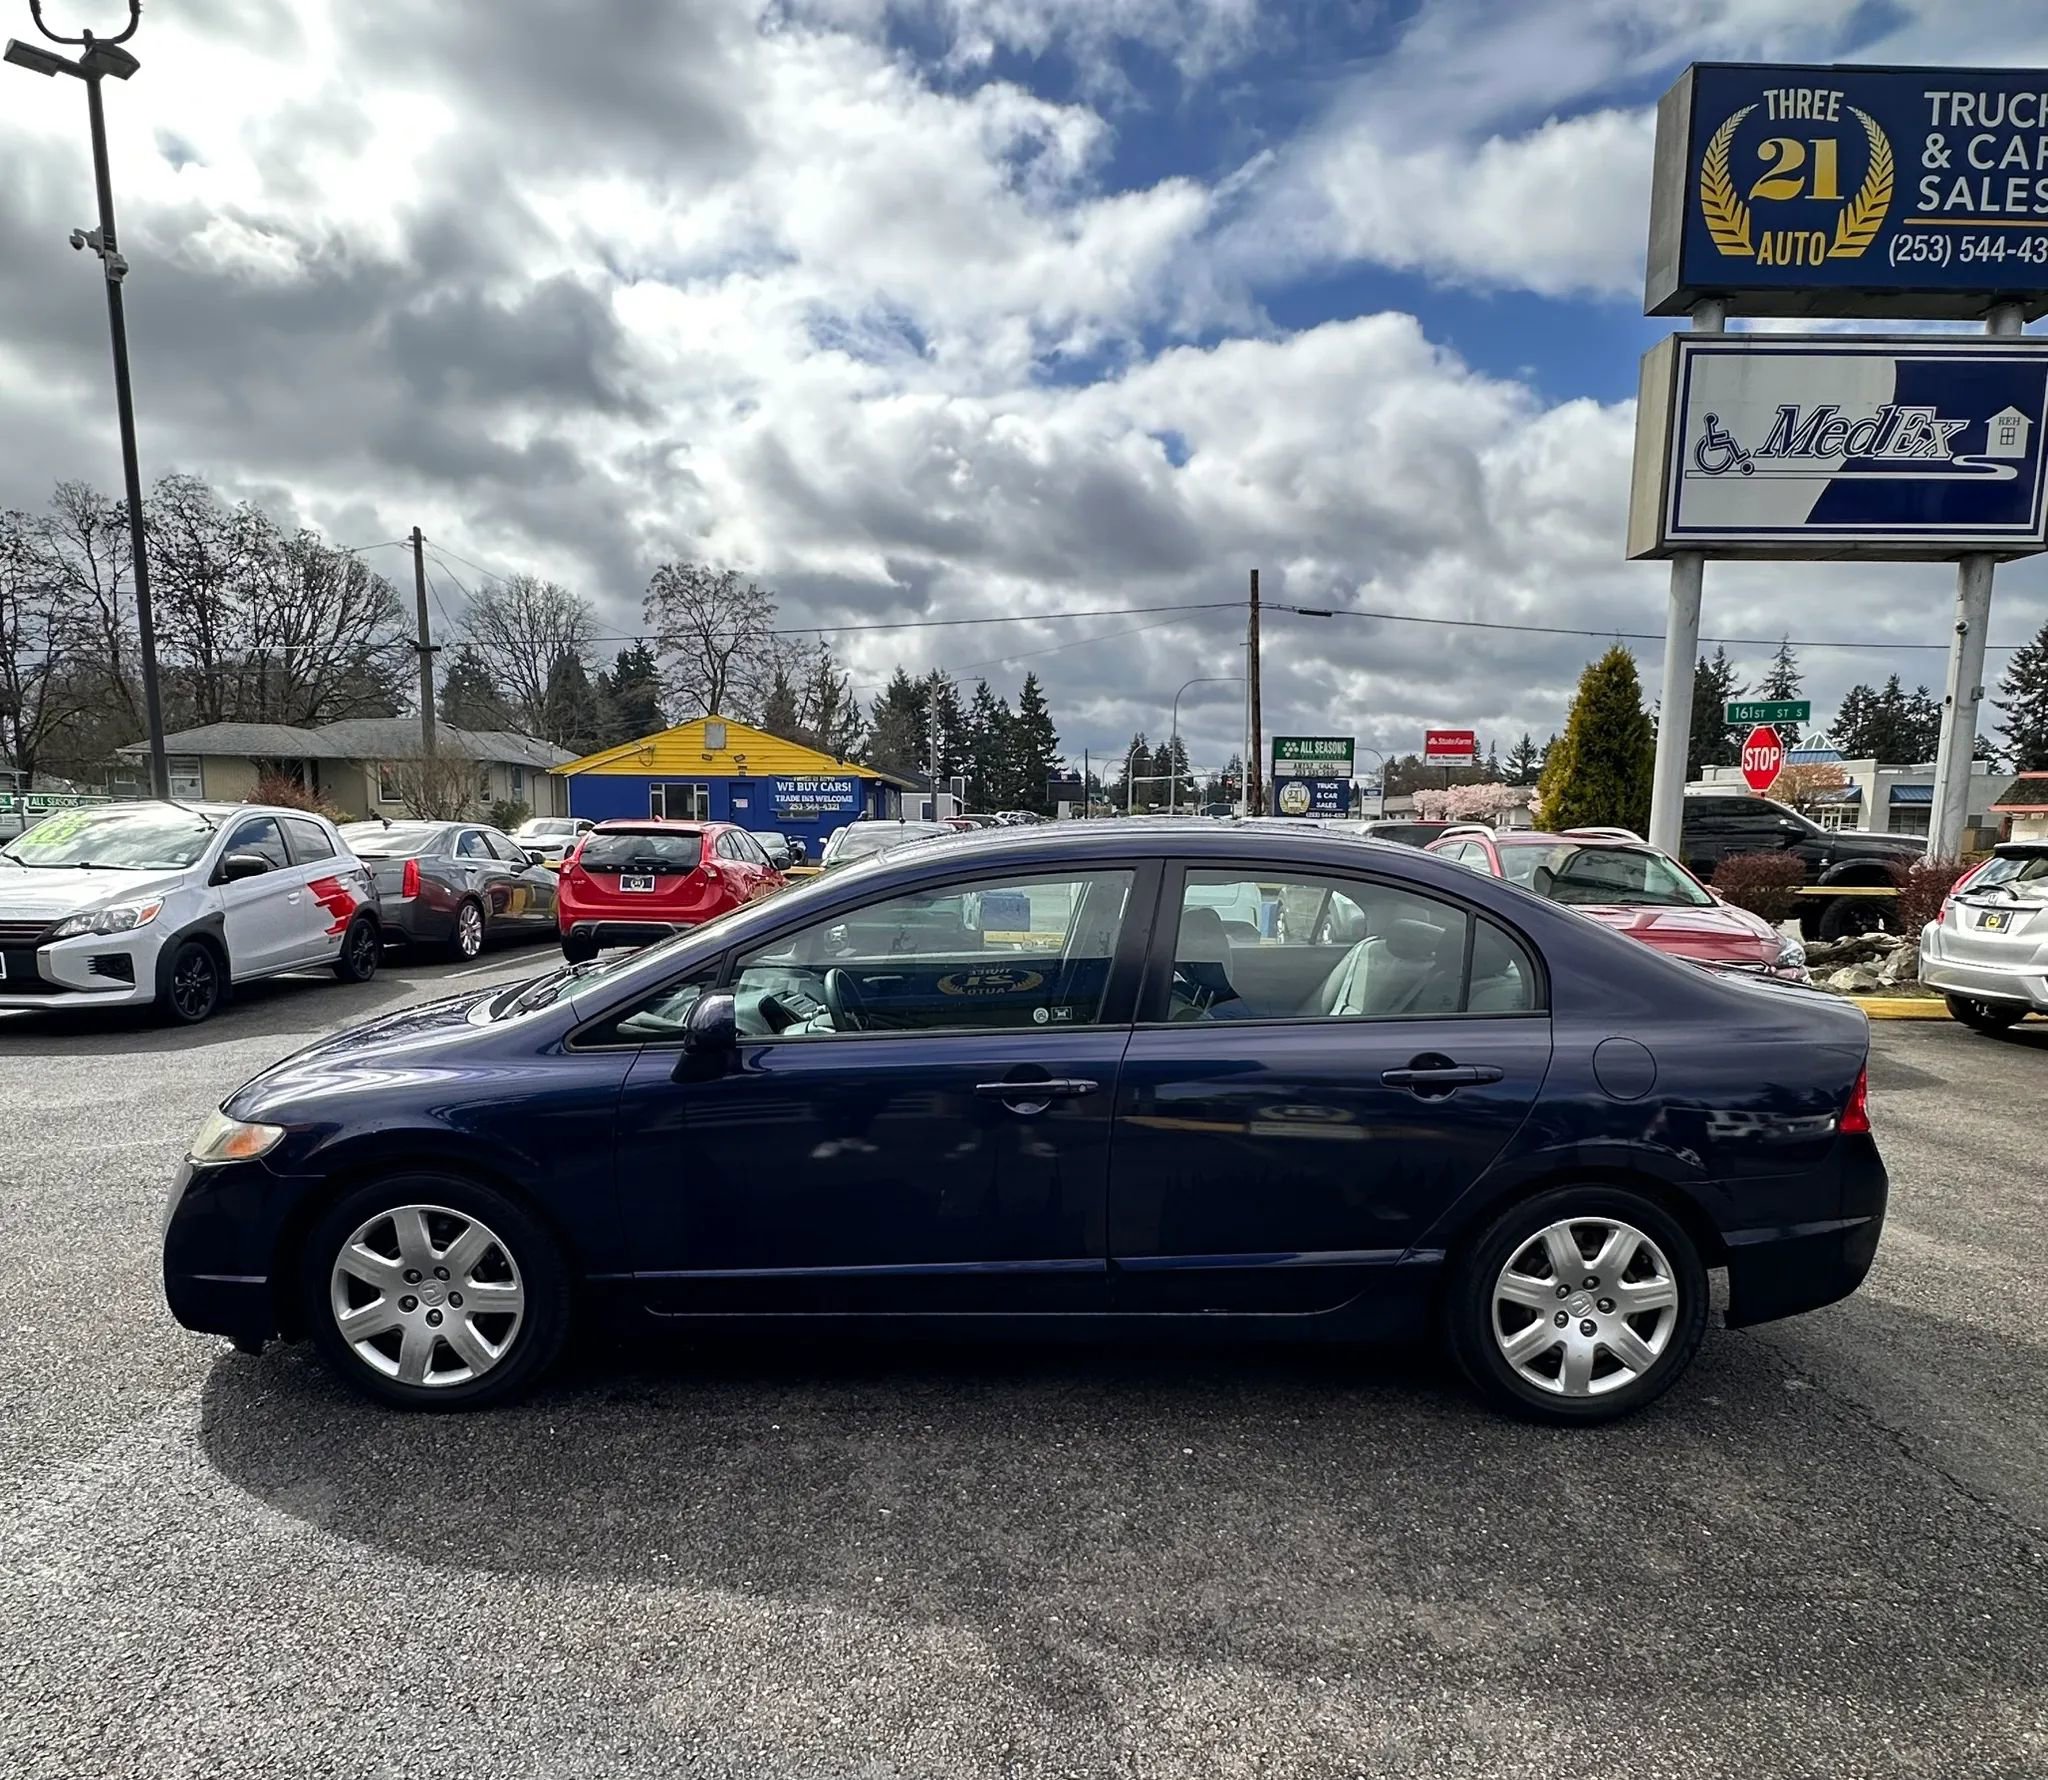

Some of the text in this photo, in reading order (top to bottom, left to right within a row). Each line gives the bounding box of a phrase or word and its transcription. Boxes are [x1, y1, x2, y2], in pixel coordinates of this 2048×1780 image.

[1763, 88, 1845, 123] THREE
[1749, 137, 1844, 200] 21
[1921, 133, 1952, 170] &
[1917, 175, 2048, 213] SALES
[1756, 230, 1826, 266] AUTO
[1888, 234, 1952, 268] (253)
[1753, 402, 1970, 460] MedEx
[1735, 706, 1803, 720] 161ST ST S
[1300, 741, 1347, 754] ALL SEASONS
[1744, 747, 1780, 771] STOP
[31, 797, 45, 806] ALL
[47, 797, 79, 807] SEASONS
[776, 782, 852, 792] WE BUY CARS!
